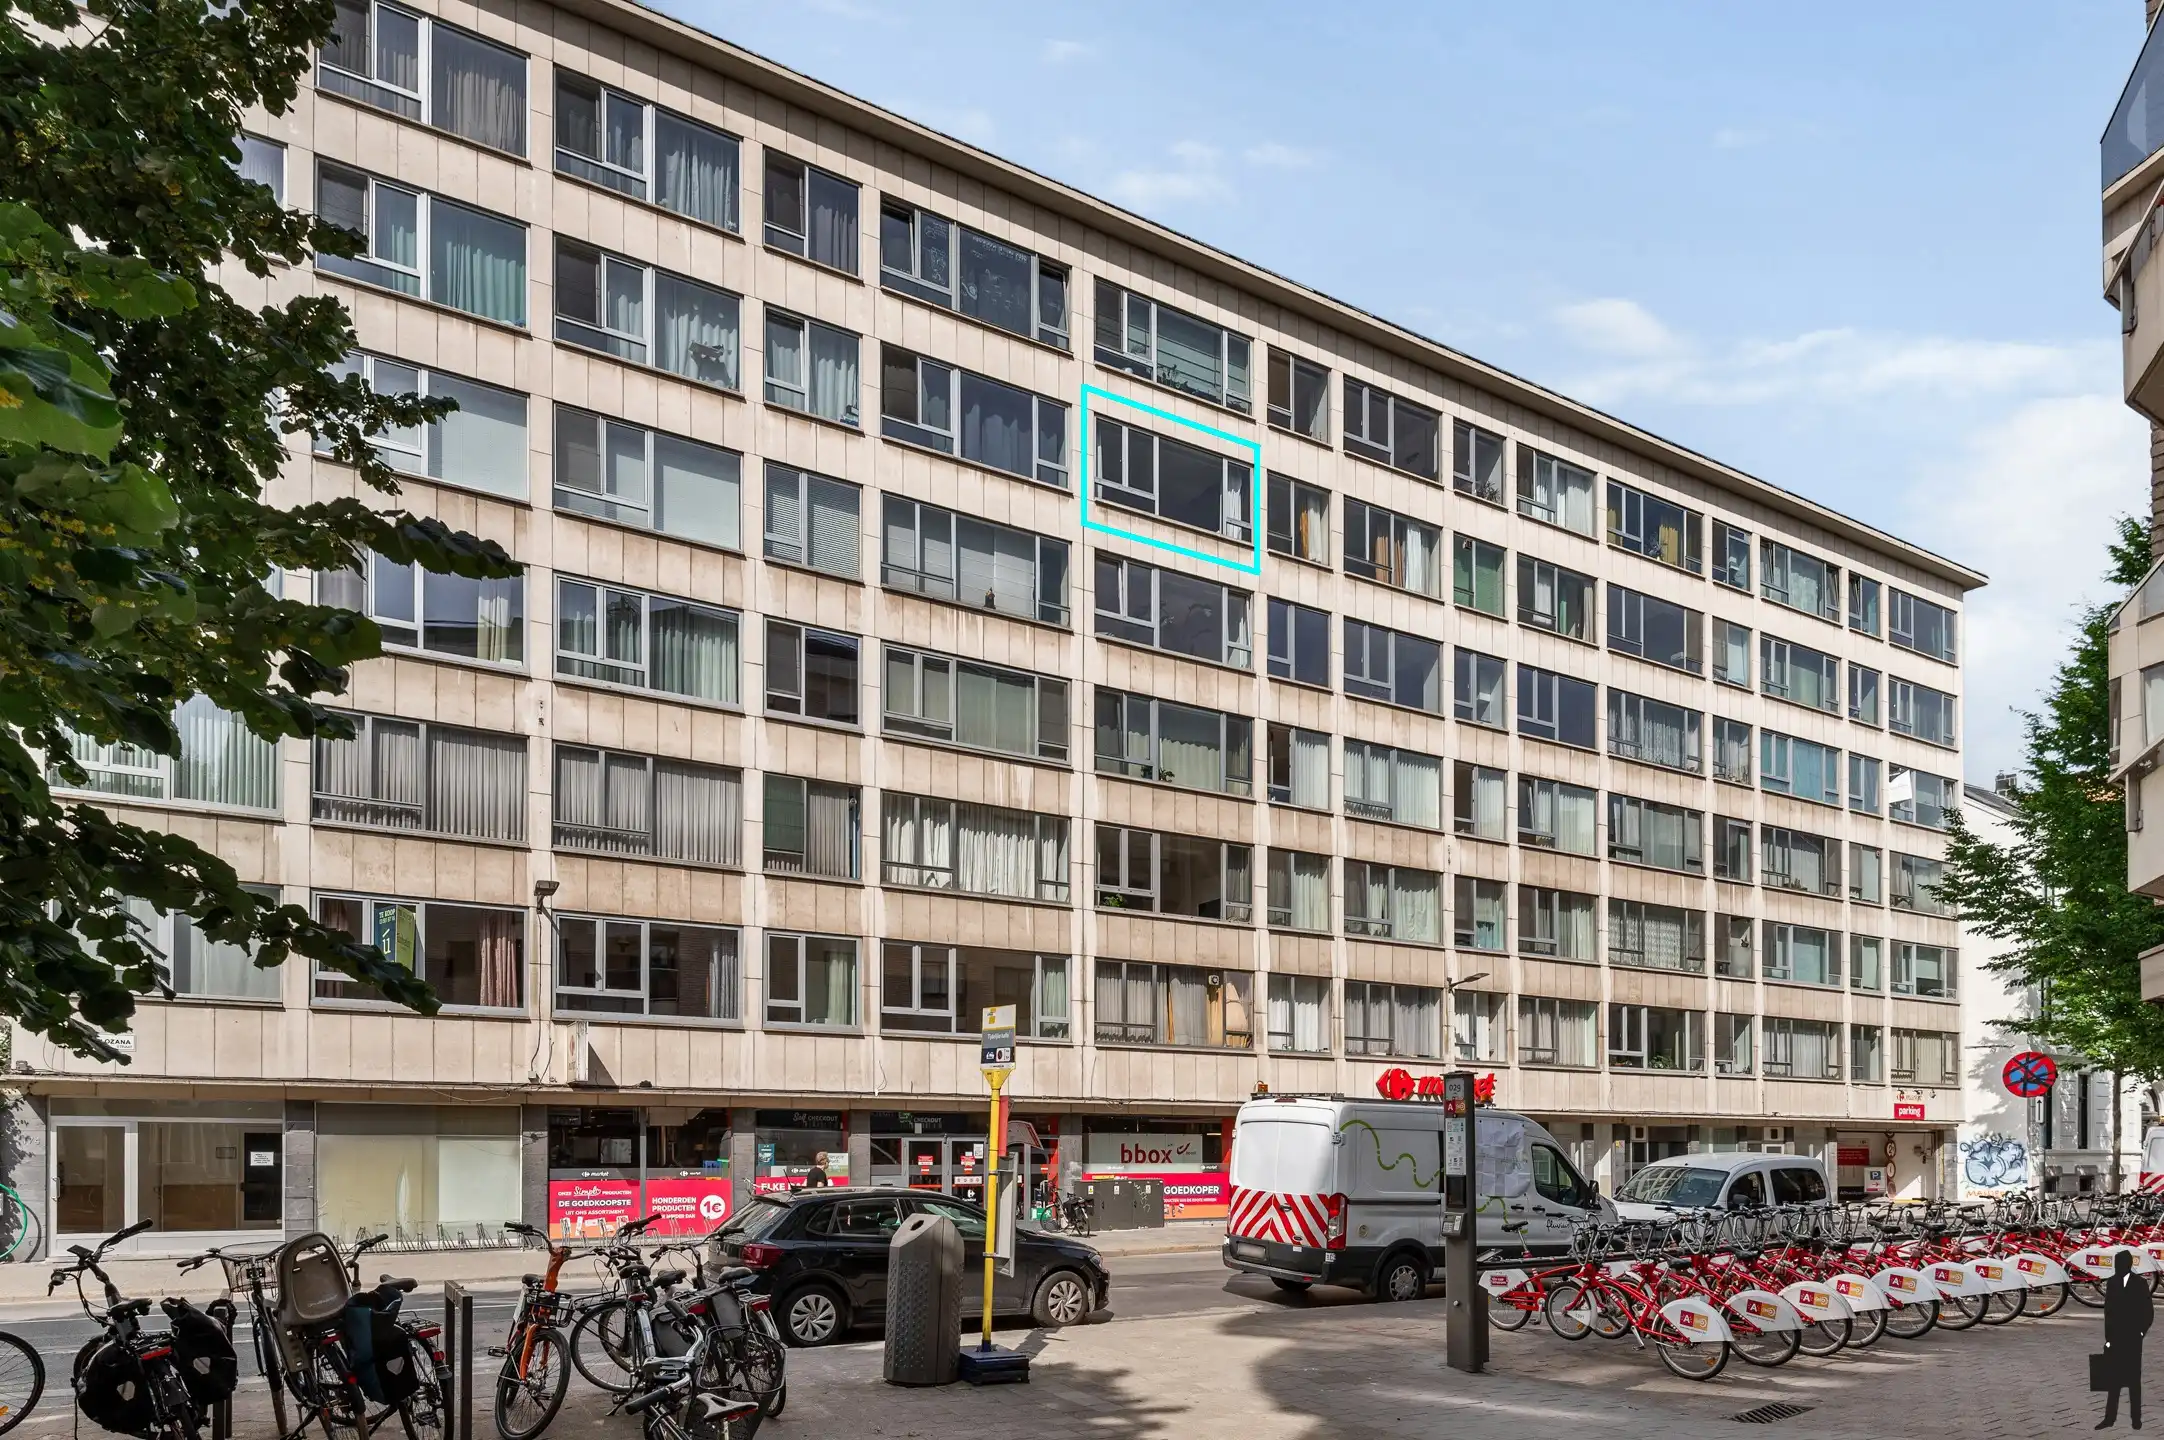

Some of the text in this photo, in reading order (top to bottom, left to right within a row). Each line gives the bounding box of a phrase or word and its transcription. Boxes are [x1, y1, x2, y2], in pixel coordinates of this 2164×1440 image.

[1449, 1084, 1461, 1093] 029
[1898, 1105, 1921, 1118] parking
[1121, 1143, 1172, 1163] bbox
[1163, 1185, 1220, 1195] GOEDKOPER
[571, 1199, 632, 1207] GOEDKOOPSTE
[652, 1204, 696, 1212] PRODUCTEN
[703, 1200, 722, 1213] 1€
